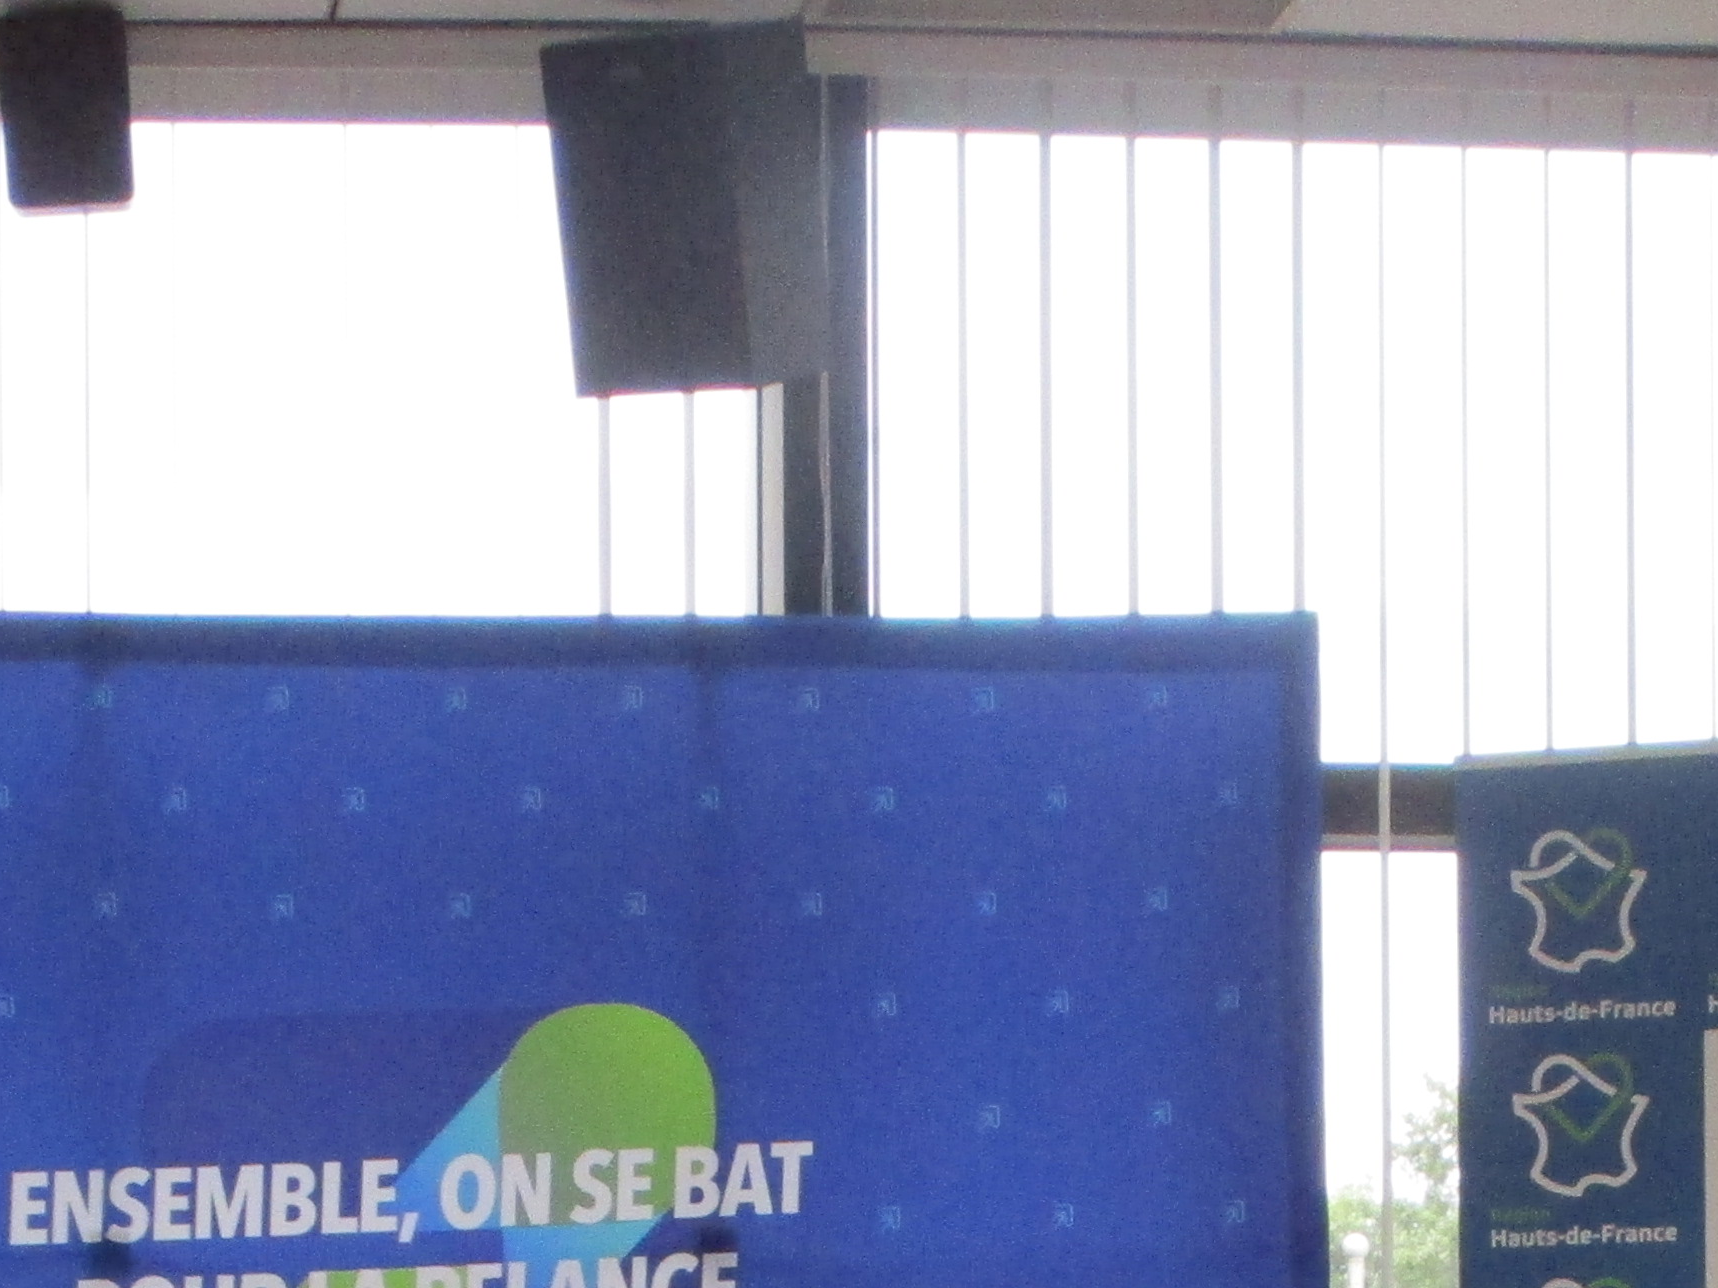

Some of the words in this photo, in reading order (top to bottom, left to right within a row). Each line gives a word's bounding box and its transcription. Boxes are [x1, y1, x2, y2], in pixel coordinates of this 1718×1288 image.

[1488, 998, 1677, 1025] Hauts-de-France
[7, 1158, 419, 1247] ENSEMBLE,
[440, 1152, 552, 1231] ON
[569, 1149, 653, 1225] SE
[672, 1141, 814, 1222] BAT
[1490, 1223, 1678, 1249] Hauts-de-France
